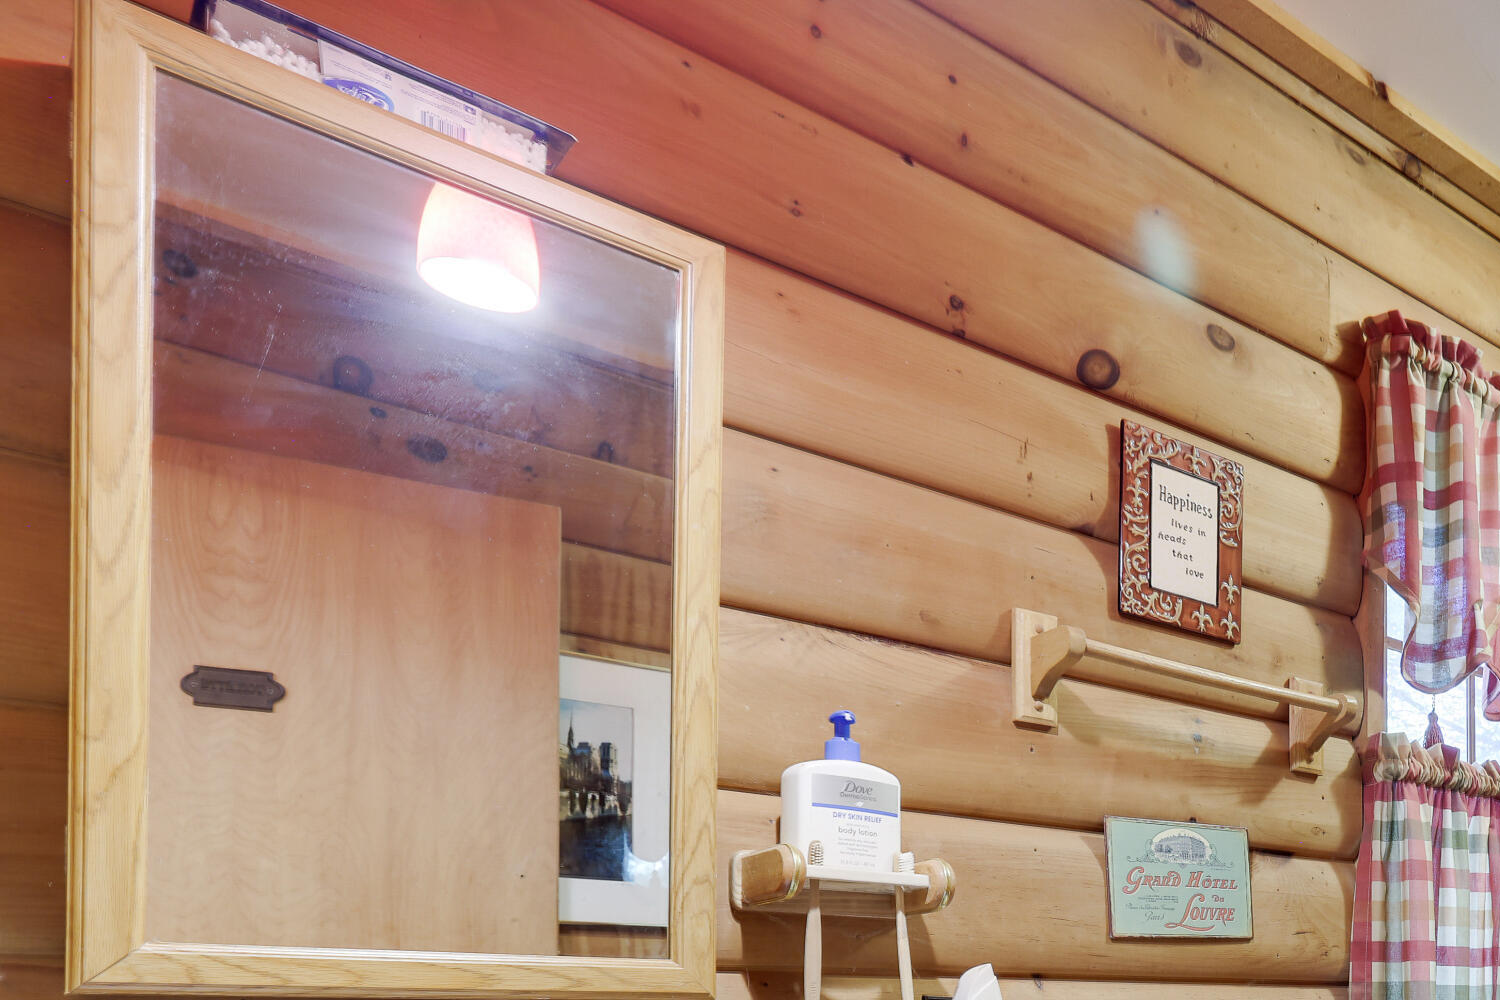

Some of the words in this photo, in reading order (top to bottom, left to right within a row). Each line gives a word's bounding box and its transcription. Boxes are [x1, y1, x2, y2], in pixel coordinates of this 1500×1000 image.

[1159, 484, 1213, 519] Happiness
[1171, 518, 1193, 533] lives
[1197, 527, 1206, 537] in
[1158, 531, 1187, 545] heads
[1172, 549, 1193, 562] that
[1185, 567, 1204, 579] love
[844, 781, 873, 796] Dove
[848, 813, 863, 821] SKIN
[864, 815, 882, 824] RELIEF
[838, 826, 856, 837] body
